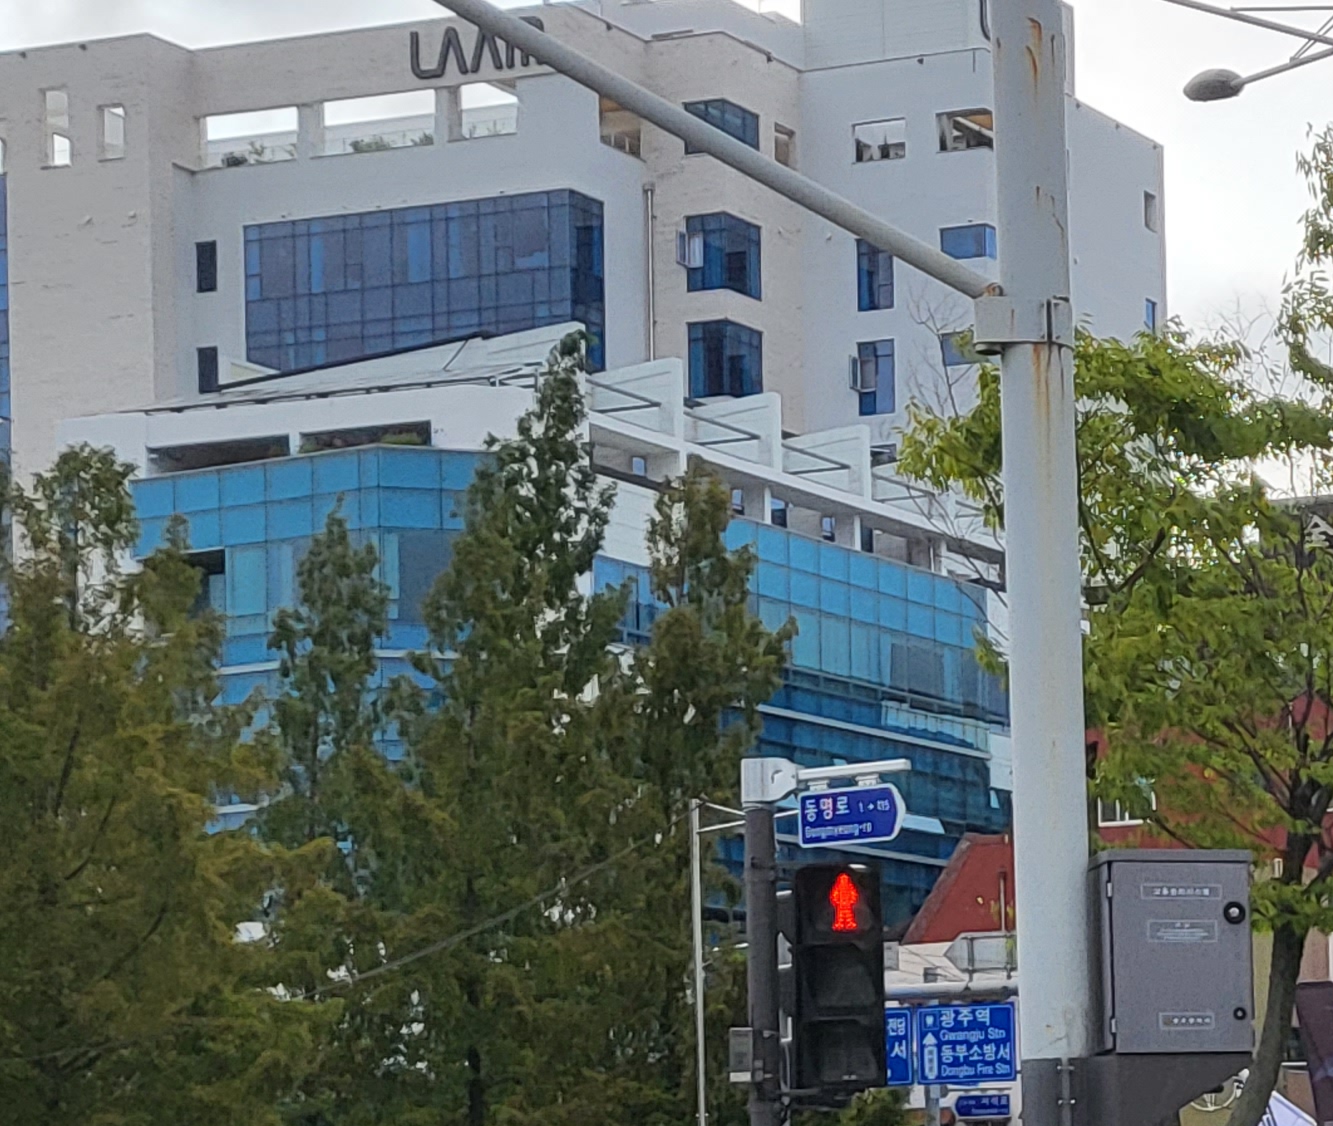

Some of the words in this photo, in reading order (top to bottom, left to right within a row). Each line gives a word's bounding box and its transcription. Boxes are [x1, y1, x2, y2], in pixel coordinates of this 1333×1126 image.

[804, 795, 850, 822] 동명로
[939, 1009, 990, 1028] 광주역
[940, 1029, 985, 1043] Gwangju
[940, 1042, 1011, 1064] 동부소방서
